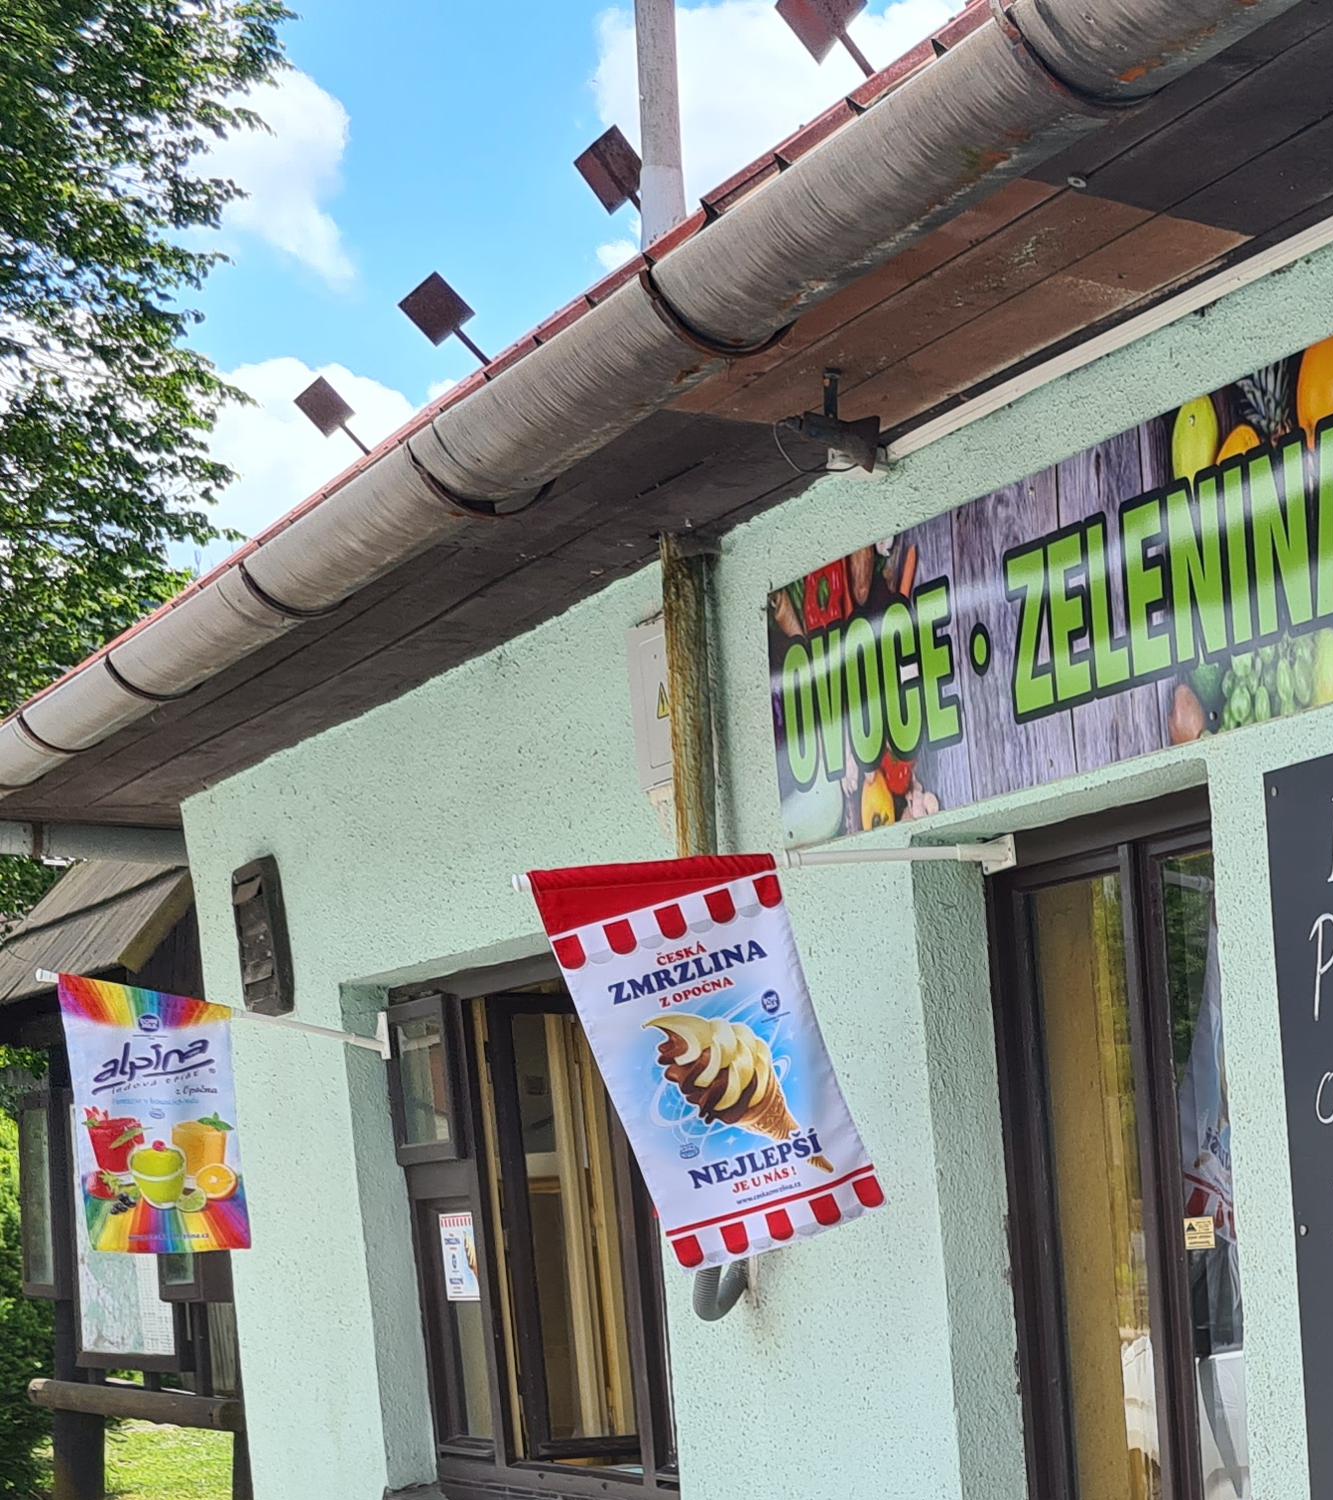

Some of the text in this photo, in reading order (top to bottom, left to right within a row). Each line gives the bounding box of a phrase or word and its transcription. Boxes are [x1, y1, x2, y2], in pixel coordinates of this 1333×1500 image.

[779, 578, 962, 788] OVOCE
[608, 940, 768, 1005] ZMRZLINA
[656, 941, 708, 966] ČESKÁ
[659, 976, 734, 1008] Z OPOČNA
[93, 1039, 210, 1082] alpina
[688, 1127, 823, 1189] NEJLEPŠÍ
[732, 1179, 750, 1194] JE
[751, 1177, 762, 1188] U
[764, 1167, 790, 1182] NÁS
